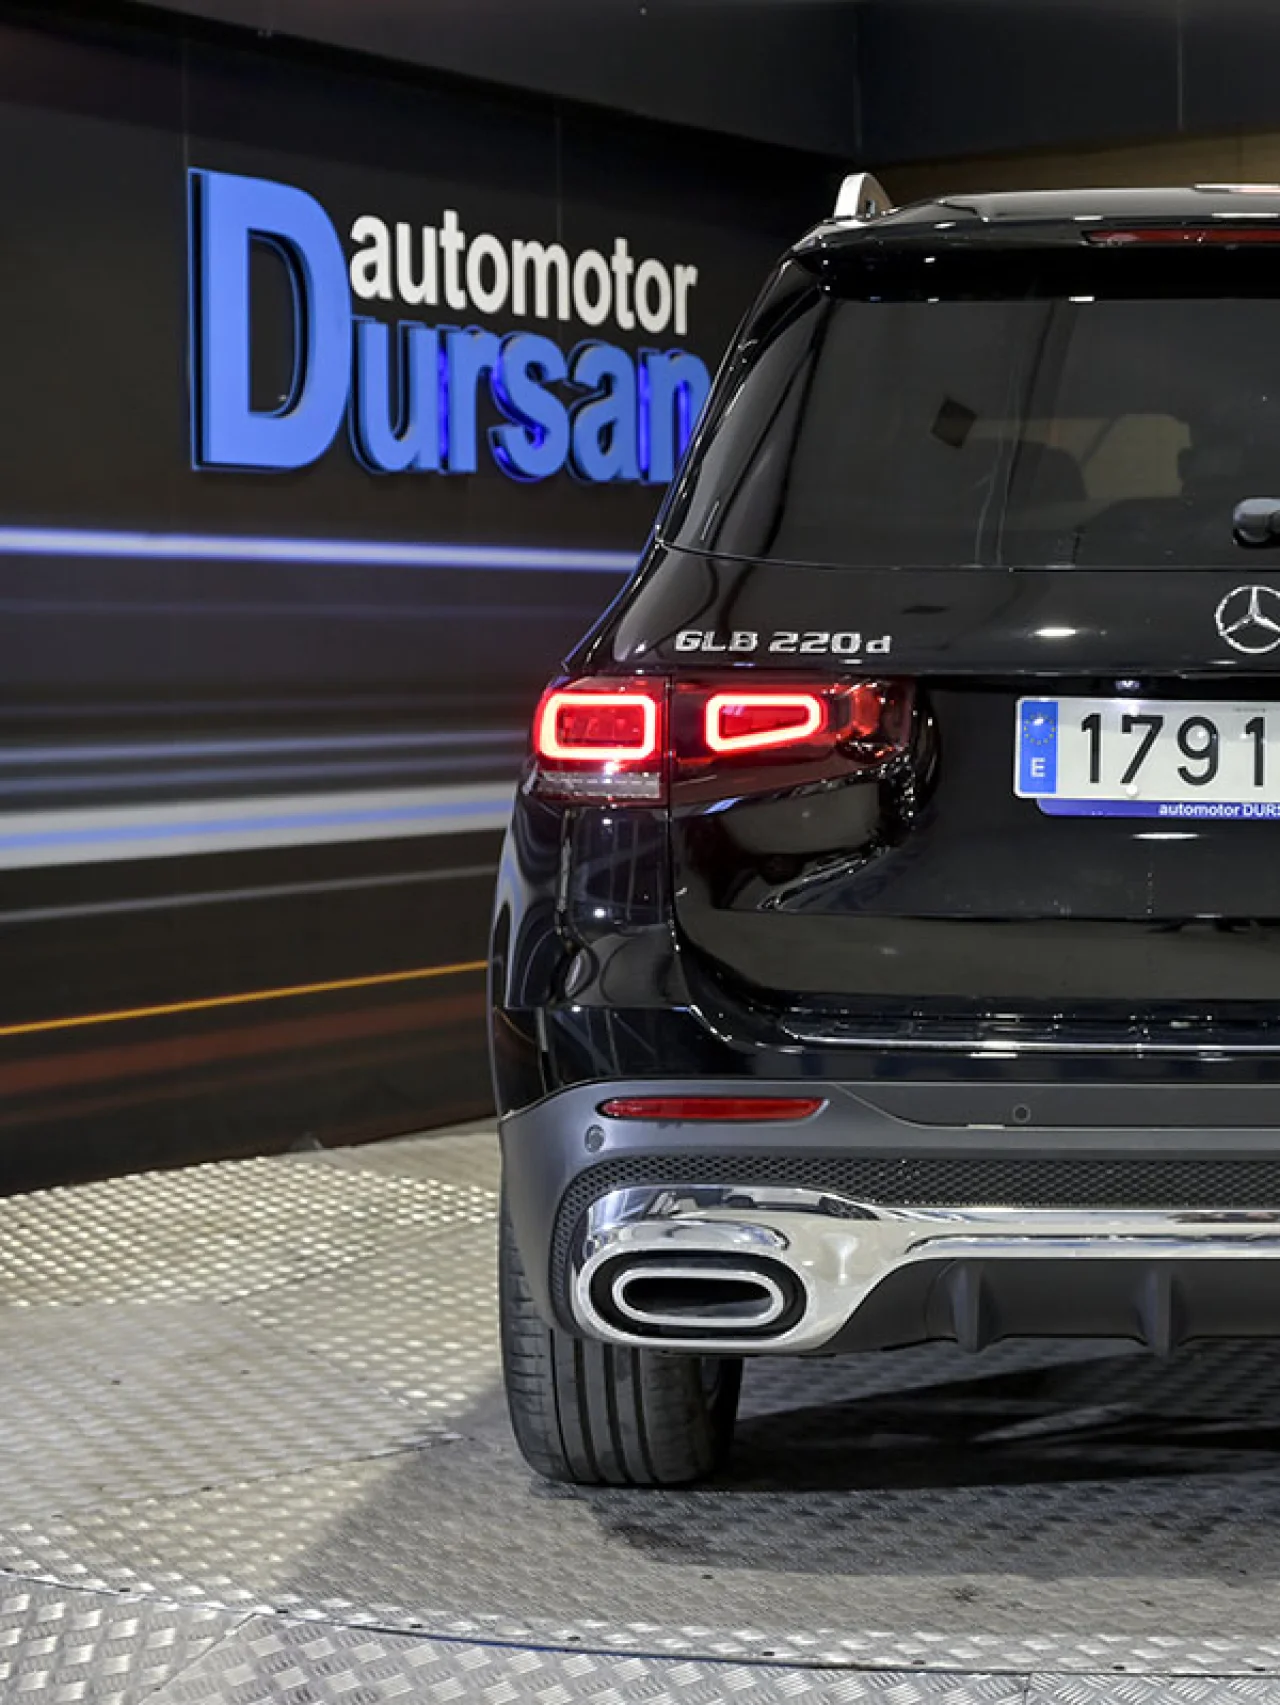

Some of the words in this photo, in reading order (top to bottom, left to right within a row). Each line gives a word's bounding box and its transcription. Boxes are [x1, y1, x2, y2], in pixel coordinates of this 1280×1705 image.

[349, 210, 699, 336] automotor
[187, 167, 712, 486] Dursan
[675, 631, 758, 652] GLB
[1030, 757, 1046, 778] E
[1081, 713, 1267, 788] 1791
[1158, 803, 1240, 817] automotor
